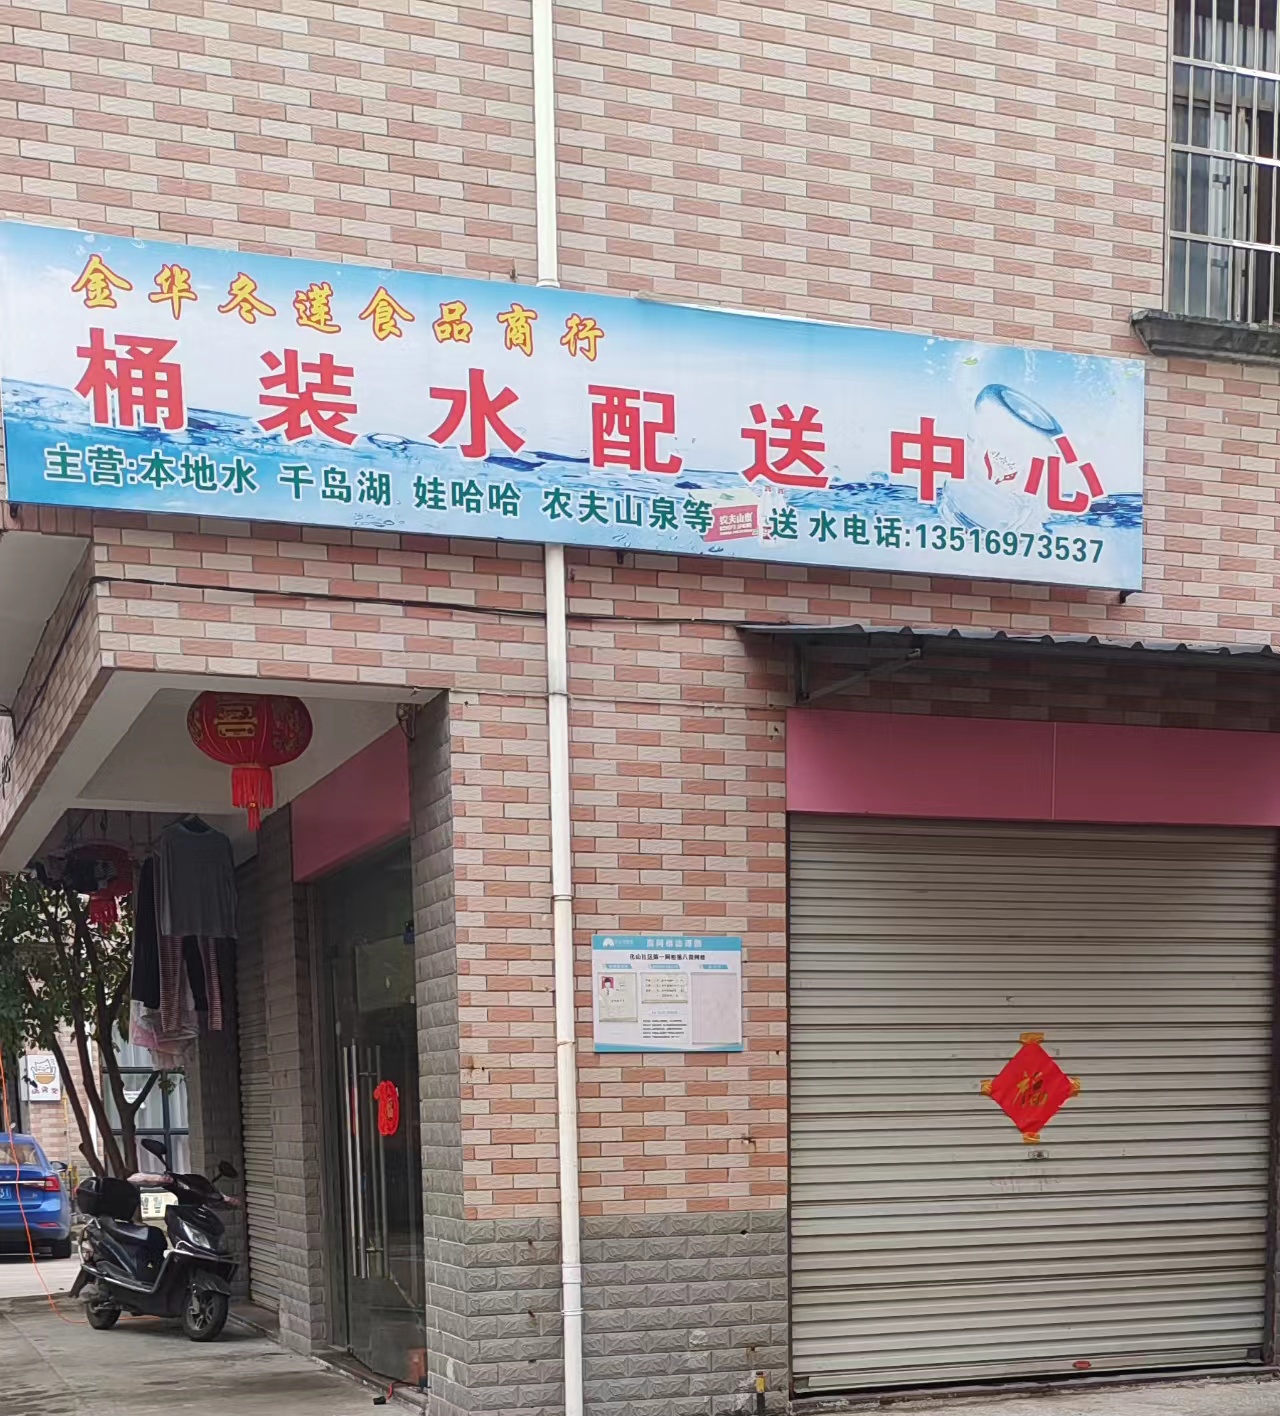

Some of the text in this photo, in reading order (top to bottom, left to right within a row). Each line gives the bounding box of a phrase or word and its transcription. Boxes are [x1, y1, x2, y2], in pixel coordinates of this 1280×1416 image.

[76, 327, 1104, 515] 桶装水配送中心
[278, 464, 392, 506] 千岛湖
[413, 479, 521, 518] 娃哈哈
[541, 488, 713, 534] 农夫山泉等
